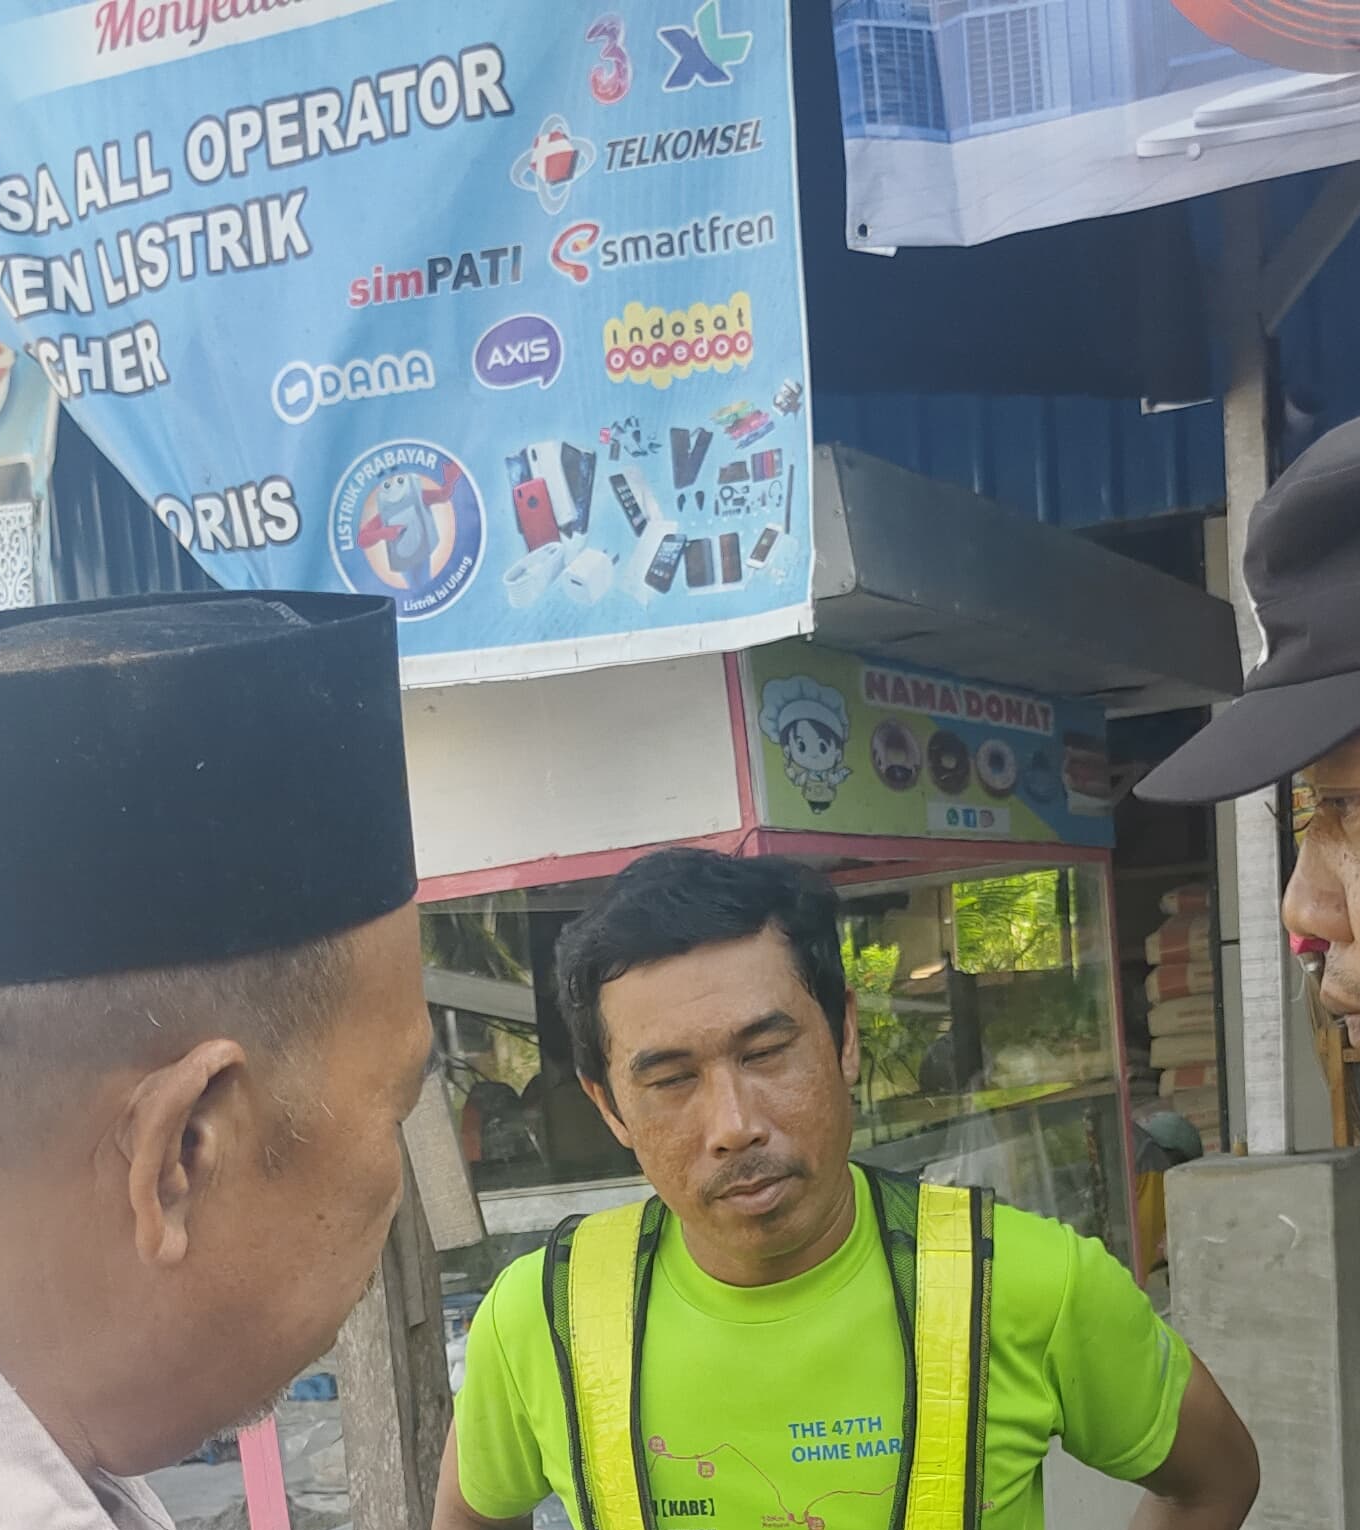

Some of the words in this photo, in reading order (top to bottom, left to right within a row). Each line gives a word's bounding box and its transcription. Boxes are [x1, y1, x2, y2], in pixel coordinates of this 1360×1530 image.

[585, 14, 632, 104] 3
[74, 132, 171, 219] ALL
[185, 43, 513, 184] OPERATOR
[605, 119, 764, 172] TELKOMSEL
[95, 189, 311, 306] LISTRIK
[600, 213, 775, 268] smartfren
[347, 245, 522, 309] simPATI
[607, 329, 751, 375] ooredoo
[610, 307, 746, 346] indosat
[320, 352, 433, 401] DANA
[486, 337, 551, 371] AXIS
[337, 486, 358, 550] LISTRIK
[356, 449, 437, 484] PRABAYAR
[403, 594, 436, 612] Listrik
[448, 556, 473, 589] Ulang
[963, 689, 1052, 732] DONAT
[788, 1421, 827, 1439] THE
[832, 1416, 882, 1435] 47TH
[791, 1443, 851, 1463] OHME
[856, 1438, 901, 1458] MAR
